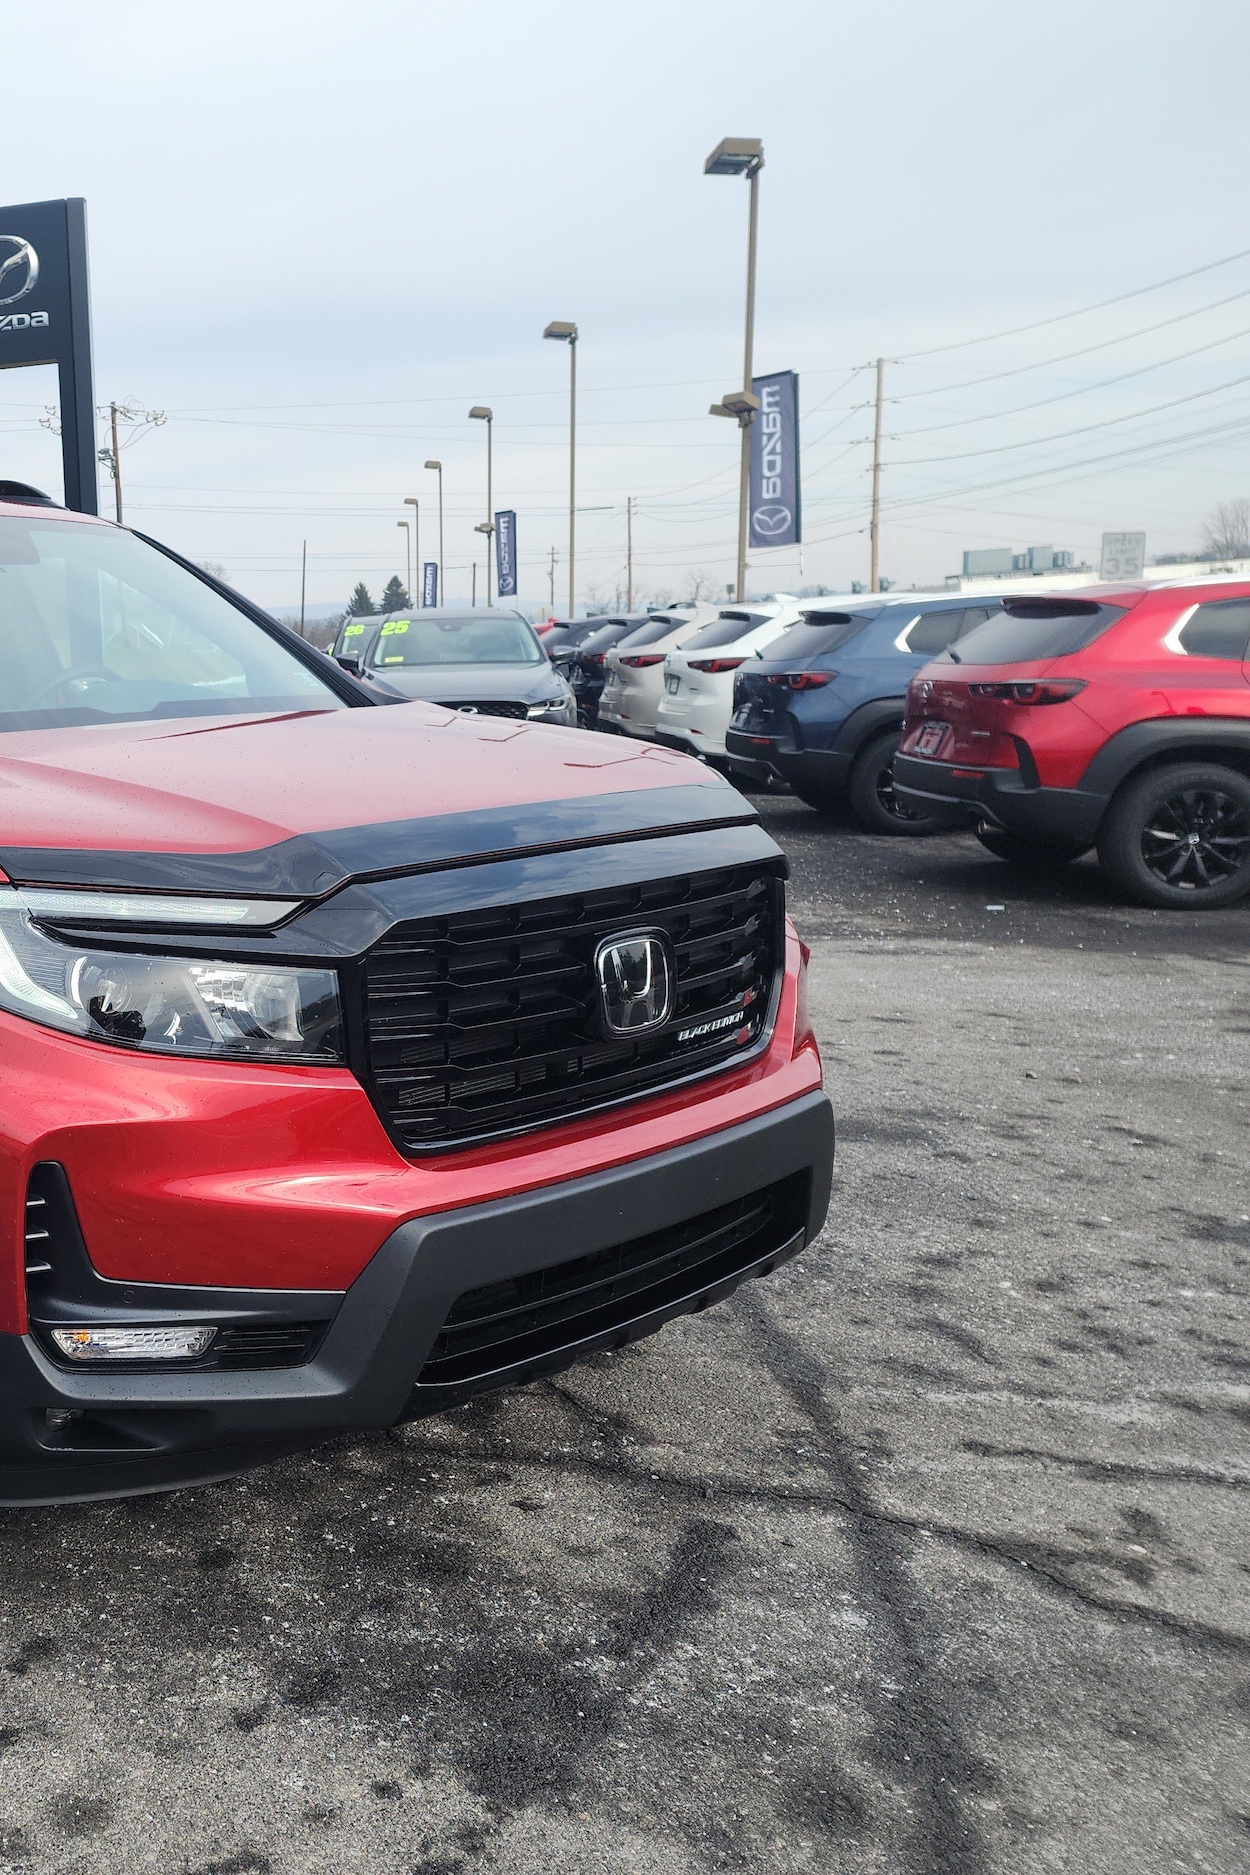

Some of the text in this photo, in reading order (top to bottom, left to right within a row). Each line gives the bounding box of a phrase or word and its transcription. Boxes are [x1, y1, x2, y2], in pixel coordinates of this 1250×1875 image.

[1110, 547, 1136, 556] LIMIT
[1106, 558, 1139, 574] 35
[344, 624, 366, 636] 26
[380, 620, 411, 636] 25
